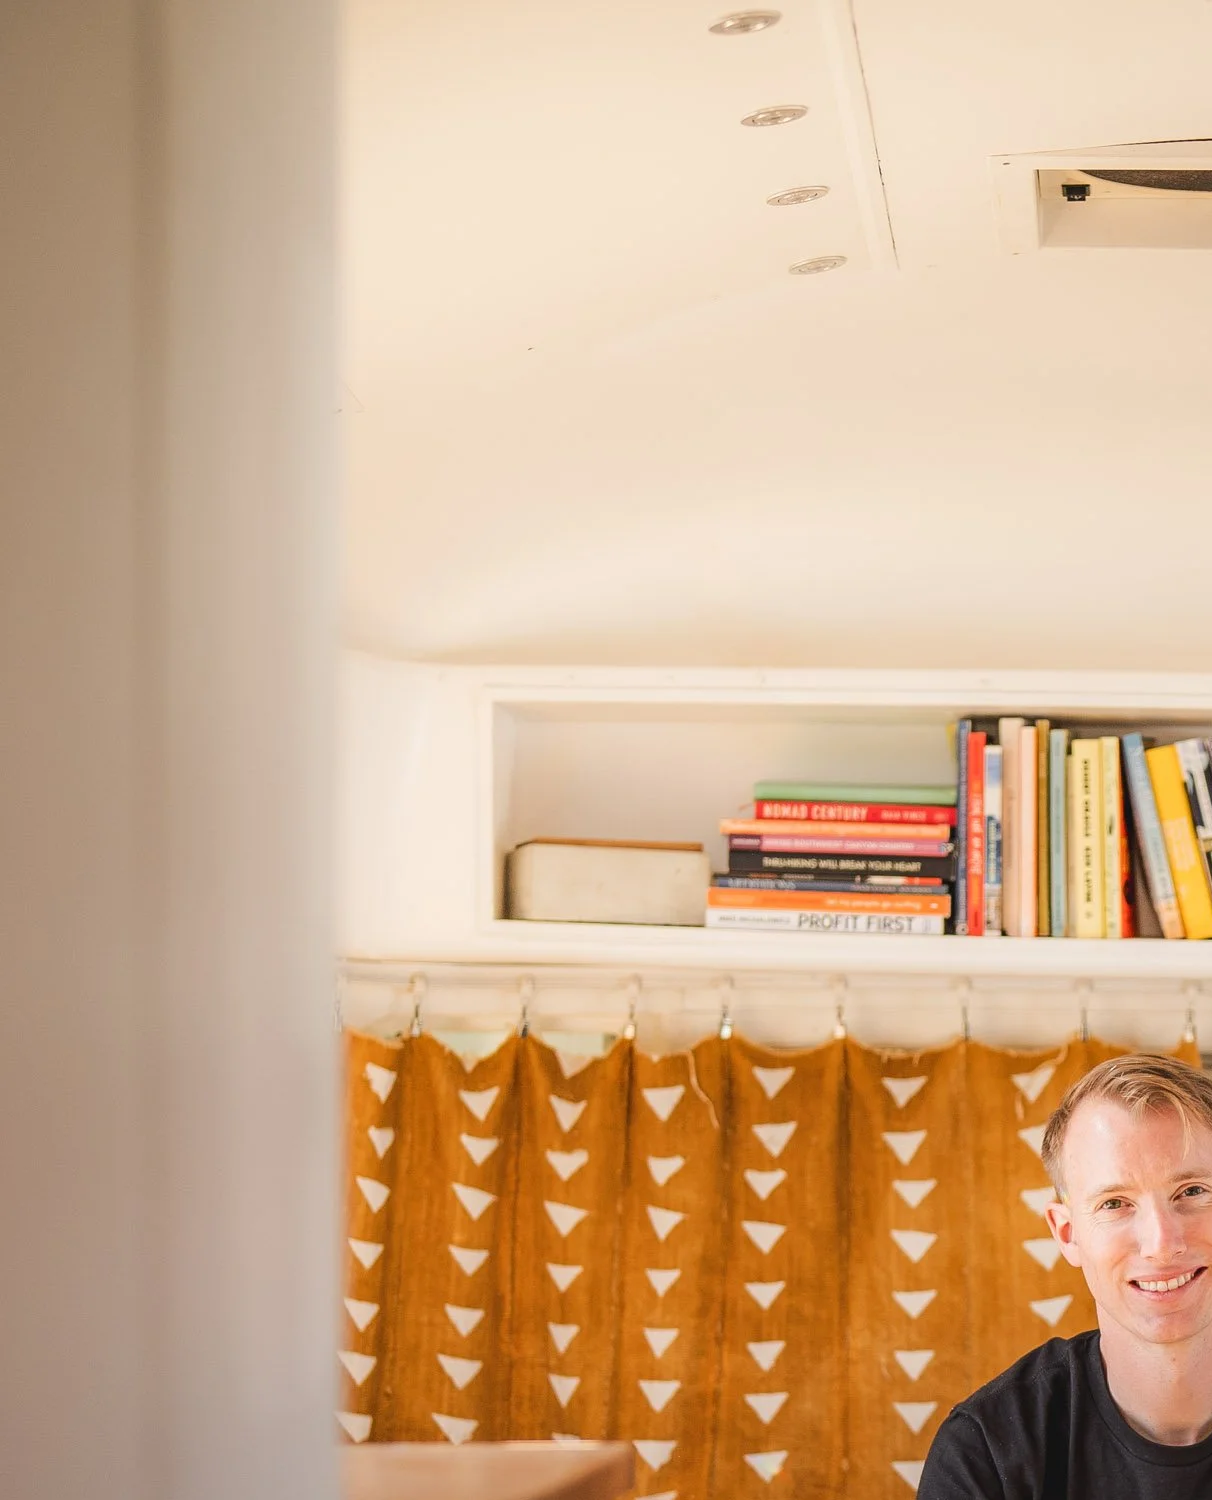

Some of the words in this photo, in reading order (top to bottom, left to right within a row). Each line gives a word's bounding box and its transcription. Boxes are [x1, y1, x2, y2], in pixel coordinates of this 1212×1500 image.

[763, 802, 808, 818] NOMAD
[811, 804, 868, 821] CENTURY
[839, 859, 866, 871] BREAK
[867, 861, 893, 872] YOUR
[894, 862, 921, 873] HEART
[798, 912, 859, 930] PROFIT
[866, 915, 913, 932] FIRST
